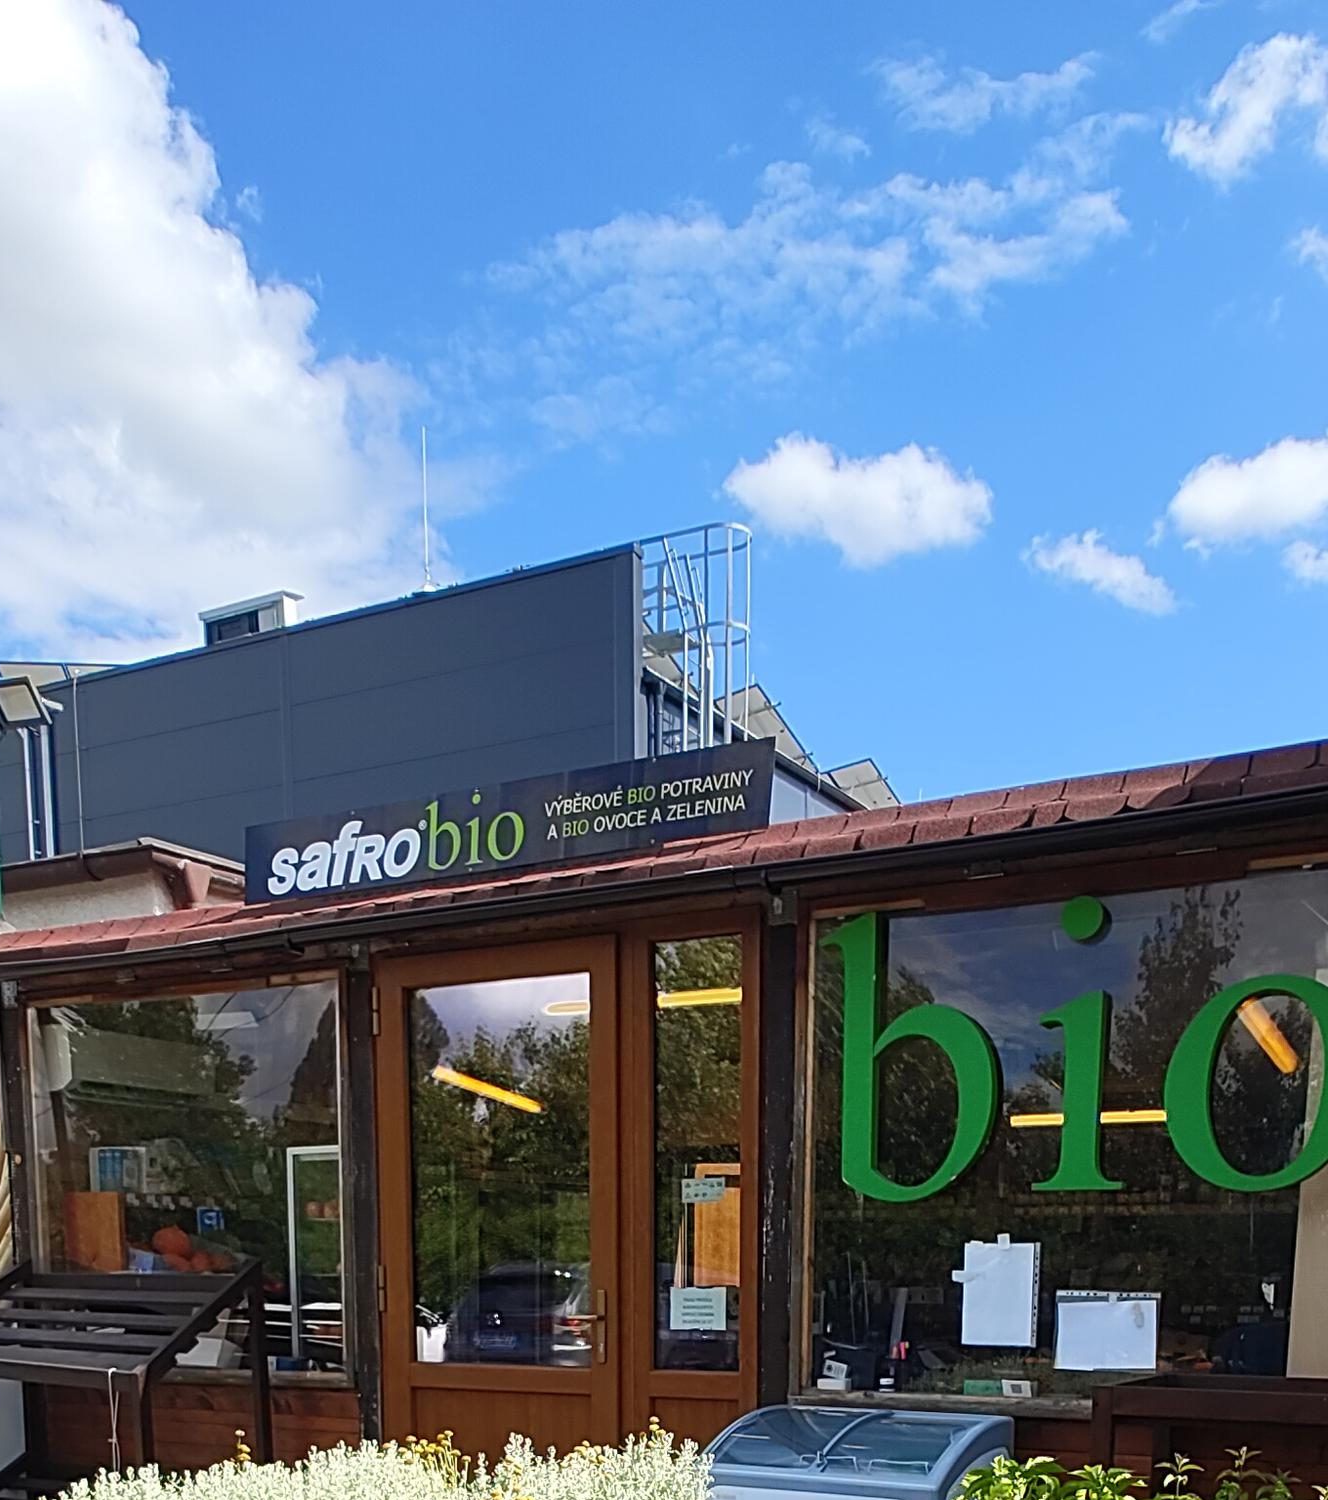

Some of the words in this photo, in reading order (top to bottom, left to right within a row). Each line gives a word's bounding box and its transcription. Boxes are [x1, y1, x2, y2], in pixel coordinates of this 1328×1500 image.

[544, 785, 623, 817] VÝBĚROVÉ
[627, 786, 656, 805] BIO
[660, 769, 754, 799] POTRAVINY
[546, 823, 558, 840] A
[562, 819, 589, 838] BIO
[593, 809, 647, 833] OVOCE
[650, 807, 662, 824] A
[666, 794, 747, 821] ZELENINA
